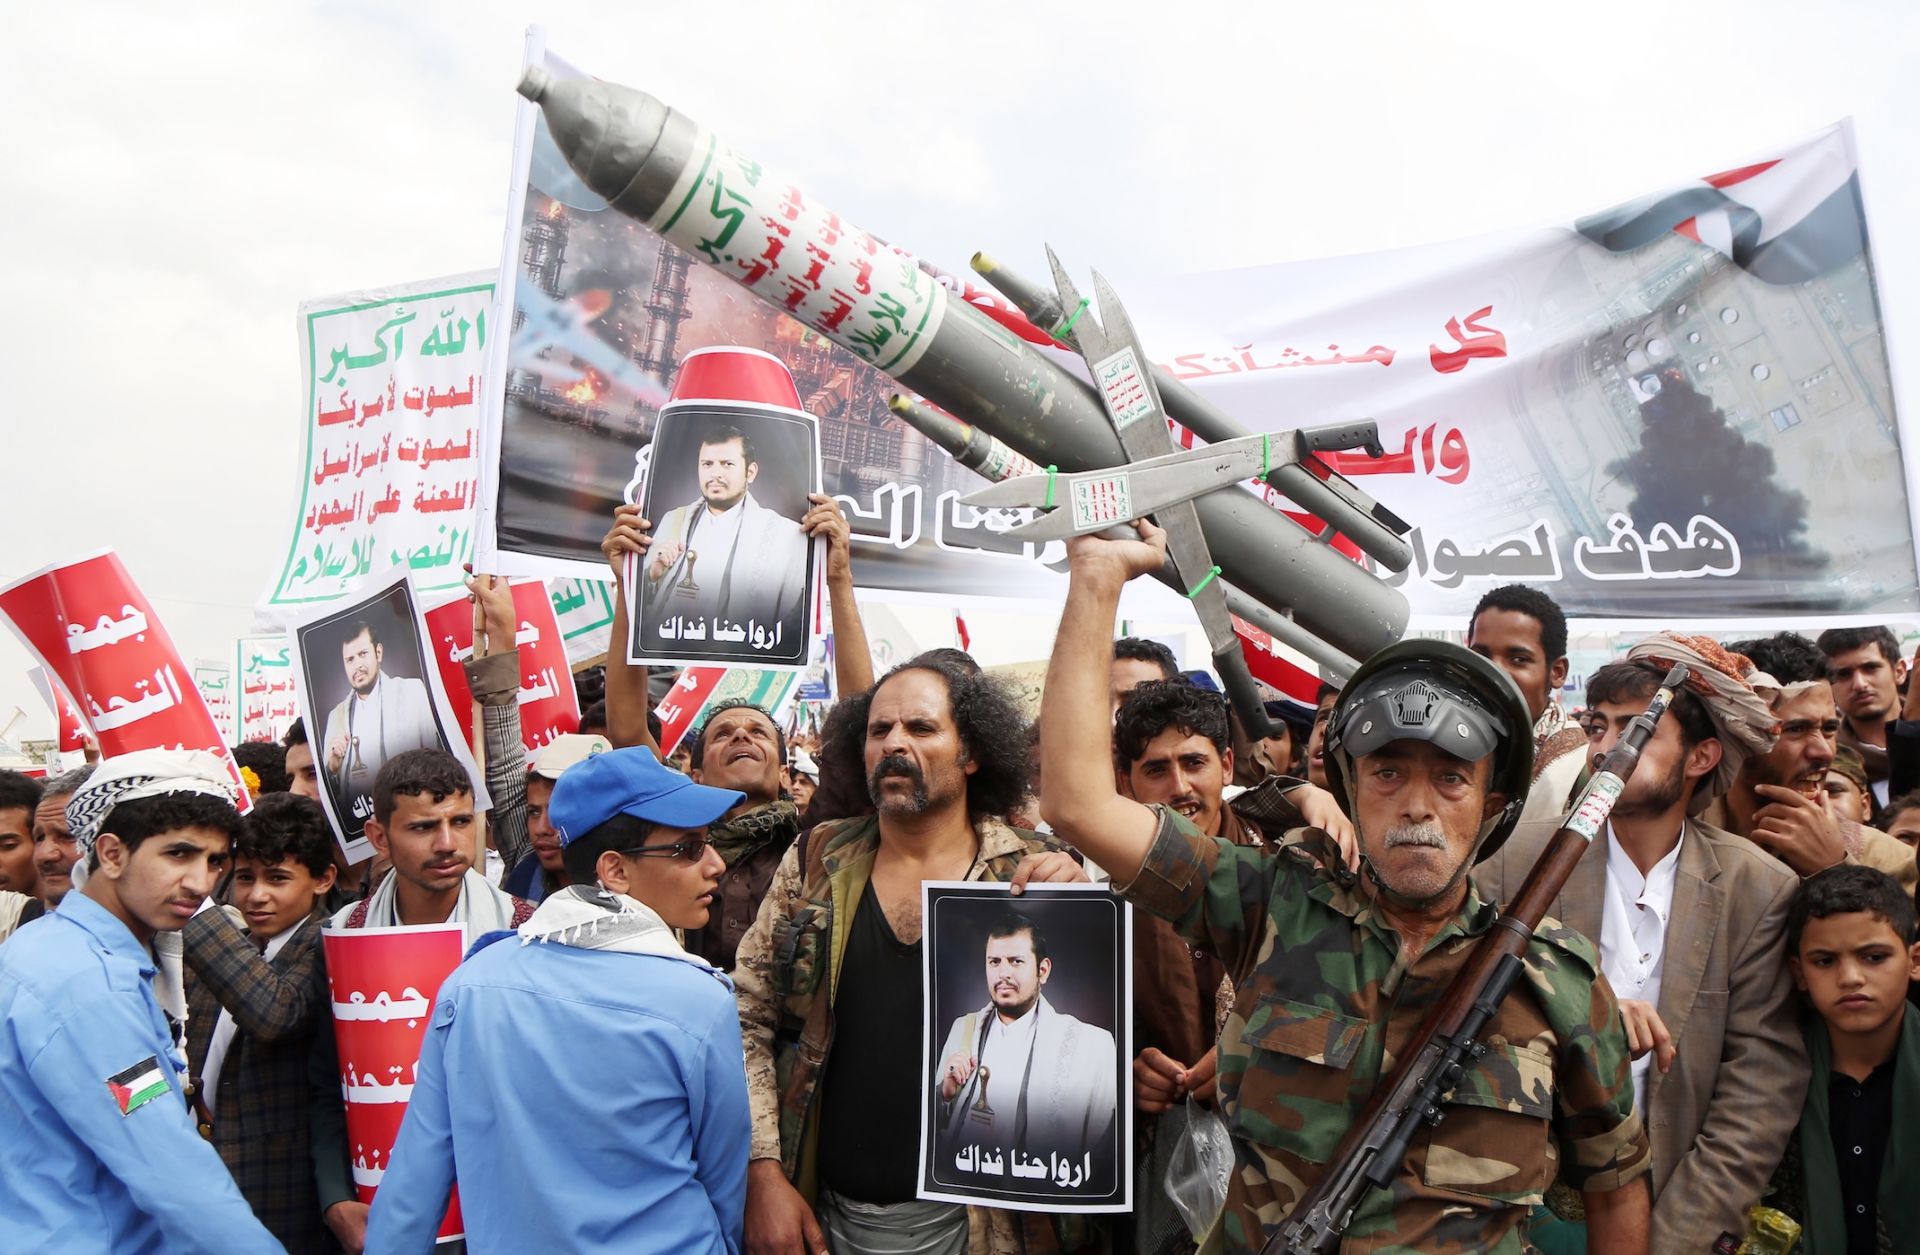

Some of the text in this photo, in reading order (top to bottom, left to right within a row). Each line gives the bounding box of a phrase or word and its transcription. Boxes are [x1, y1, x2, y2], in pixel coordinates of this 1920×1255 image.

[318, 306, 486, 388] الله أكبر
[1429, 304, 1508, 375] كل
[318, 374, 396, 429] لأمريكا
[314, 432, 392, 486] لإسرائيل
[306, 479, 478, 535] اللعنة على اليهود
[286, 533, 376, 593] للإسلام
[1577, 516, 1738, 577] هدف
[58, 604, 149, 655] جمع
[658, 614, 783, 651] ارواحنا فداك
[243, 647, 290, 675] كبر
[86, 663, 184, 733] التحذ
[954, 1143, 1091, 1189] ارواحنا فداك
